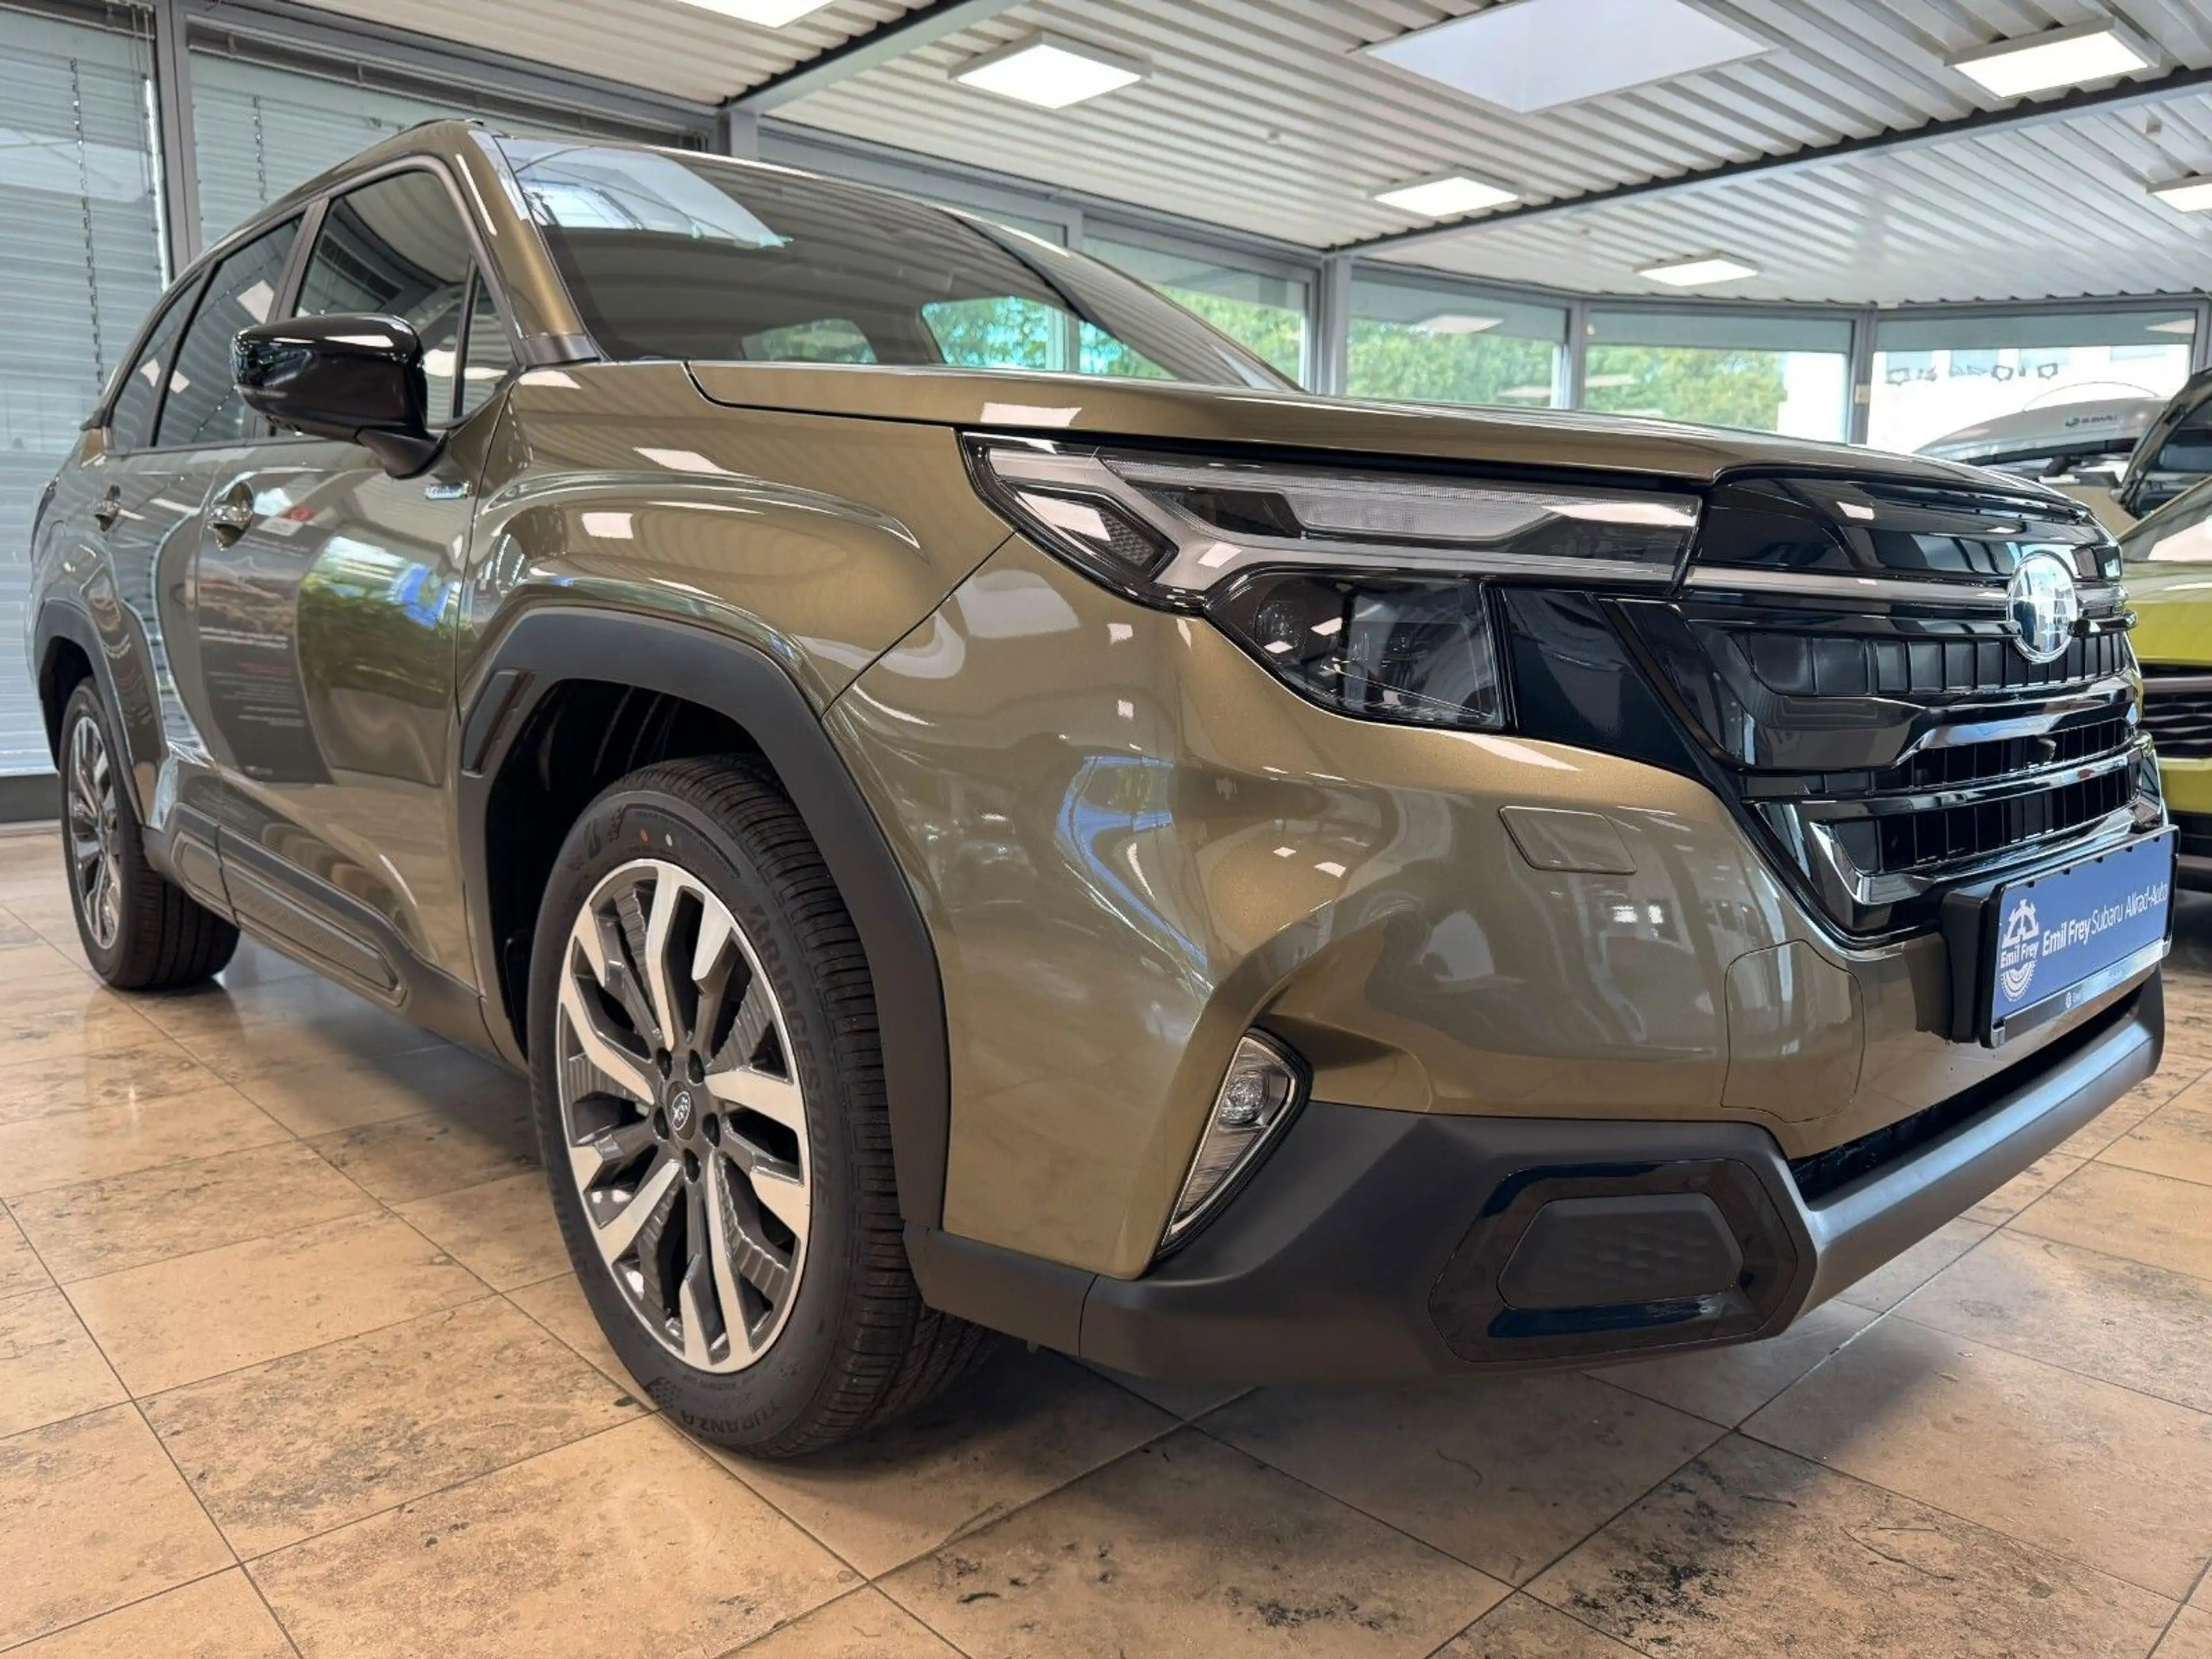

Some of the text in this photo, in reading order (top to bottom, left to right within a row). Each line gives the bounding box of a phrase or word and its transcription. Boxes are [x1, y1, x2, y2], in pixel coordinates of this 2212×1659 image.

[2041, 881, 2168, 957] Emil Frey Subaru Allrad-Auto
[2001, 941, 2040, 969] Emil Frey
[680, 1400, 782, 1434] TURANZA
